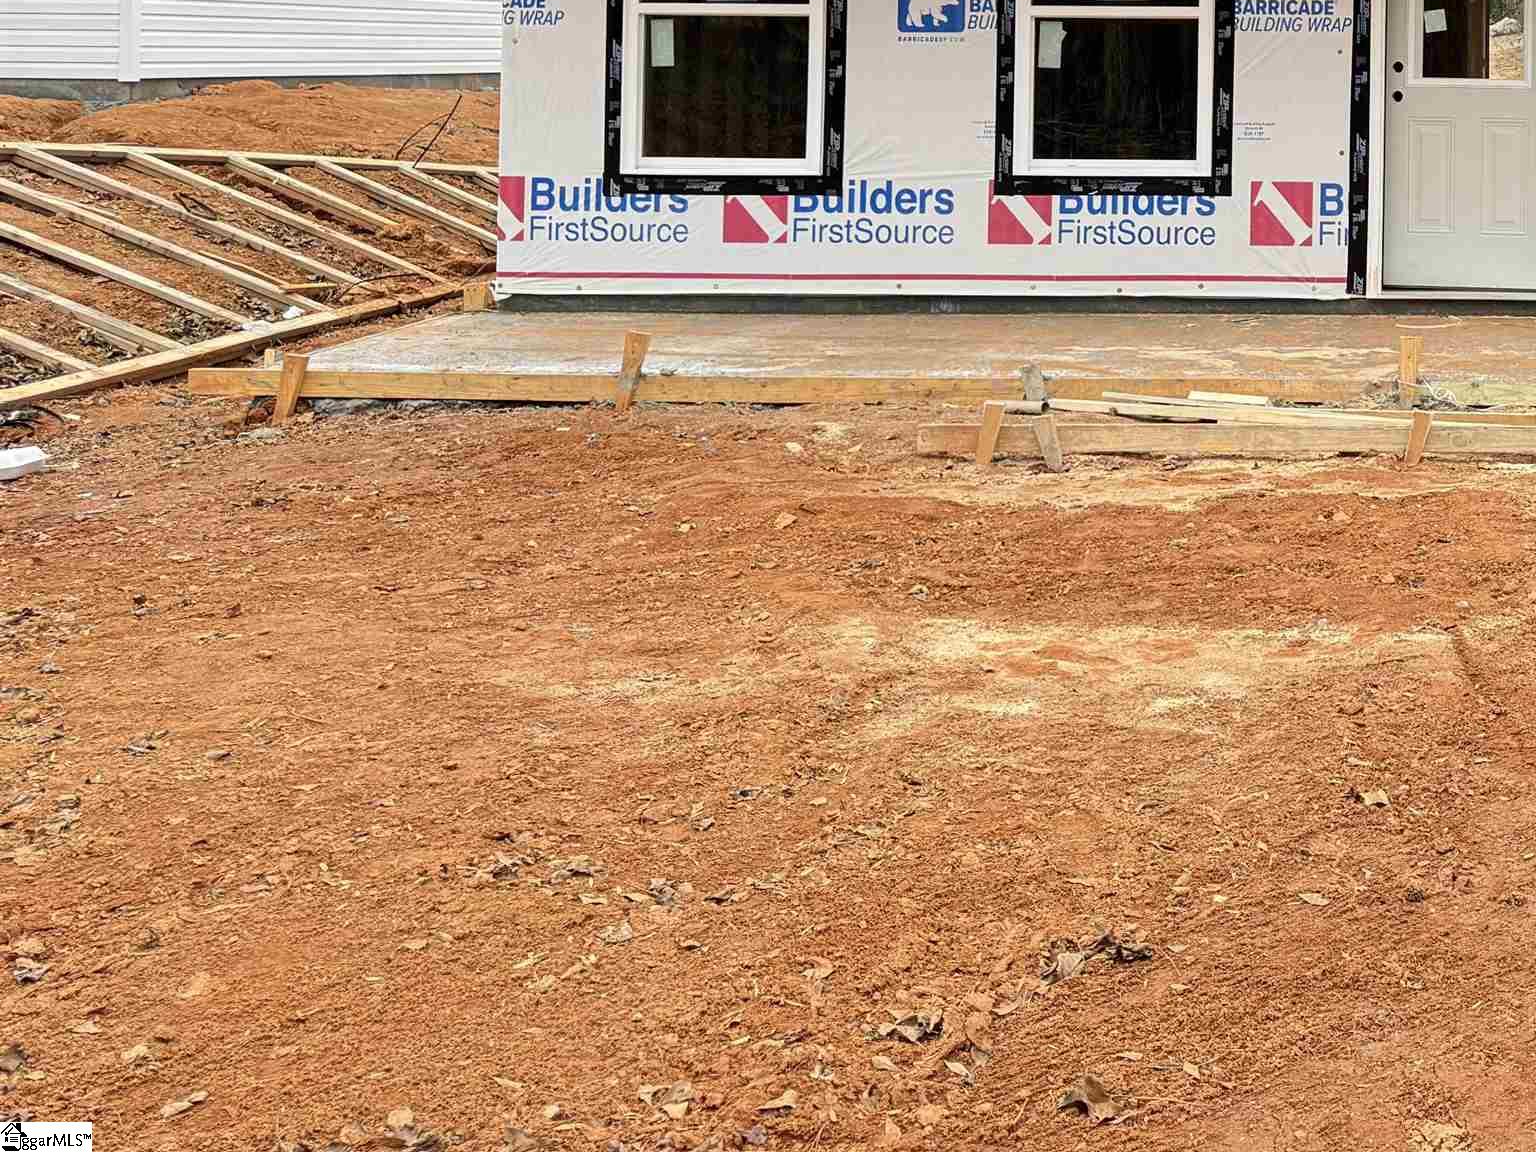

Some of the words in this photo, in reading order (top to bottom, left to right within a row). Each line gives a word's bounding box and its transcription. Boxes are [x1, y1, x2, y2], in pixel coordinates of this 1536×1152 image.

[520, 9, 565, 26] WRAP
[1232, 0, 1335, 16] BARRICADE
[1308, 16, 1352, 33] WRAP
[530, 215, 689, 243] FirstSource
[793, 218, 955, 244] FirstSource
[1058, 219, 1216, 246] FirstSource
